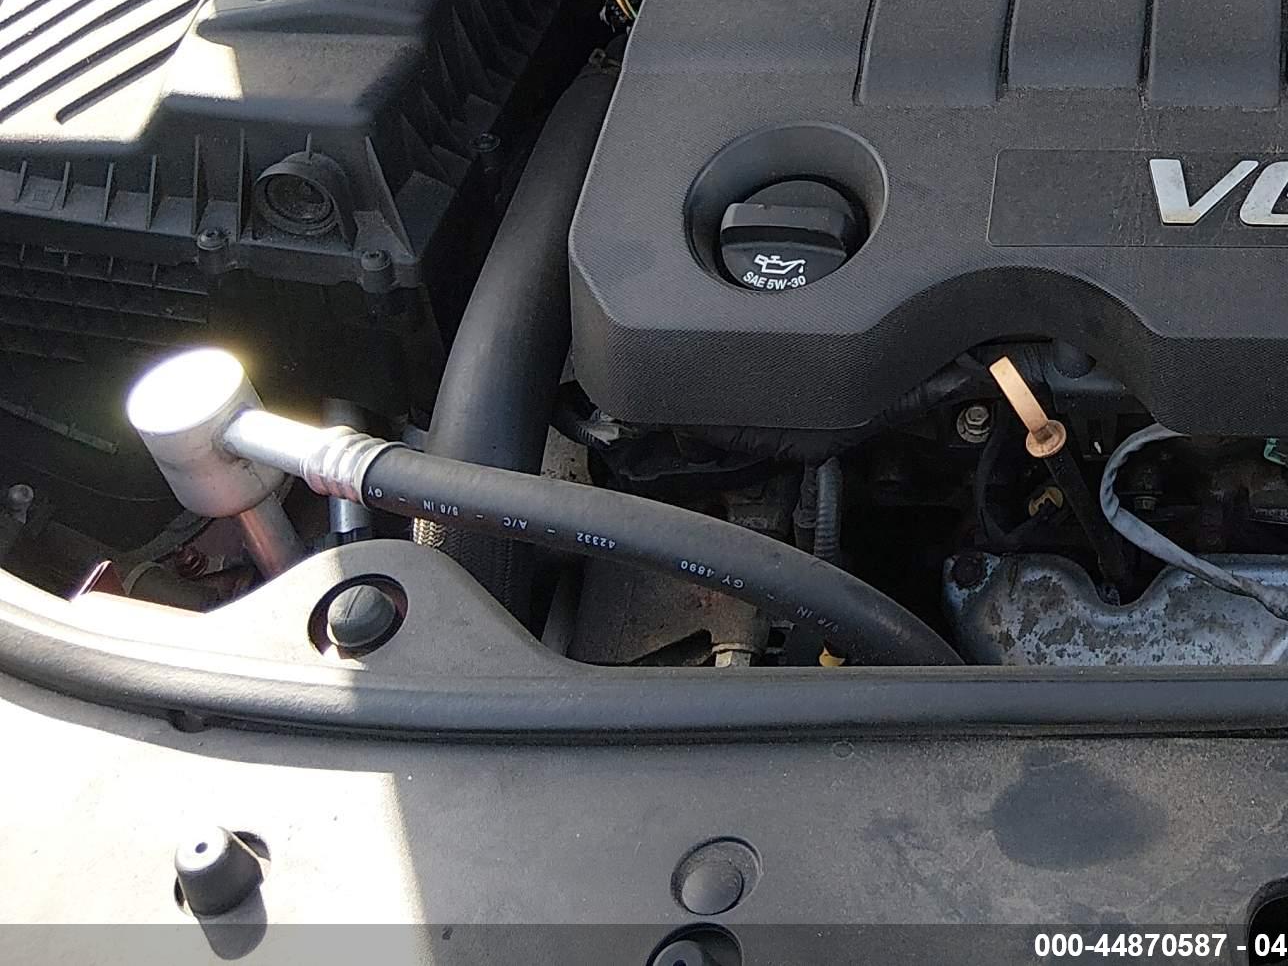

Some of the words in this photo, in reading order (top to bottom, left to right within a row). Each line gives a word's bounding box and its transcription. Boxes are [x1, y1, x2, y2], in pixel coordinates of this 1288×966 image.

[743, 271, 767, 288] SAE
[766, 275, 806, 290] 5W-30
[368, 486, 383, 498] GY
[423, 500, 434, 511] IN
[503, 517, 528, 530] A/C
[577, 532, 616, 549] 42332
[722, 575, 744, 589] GY
